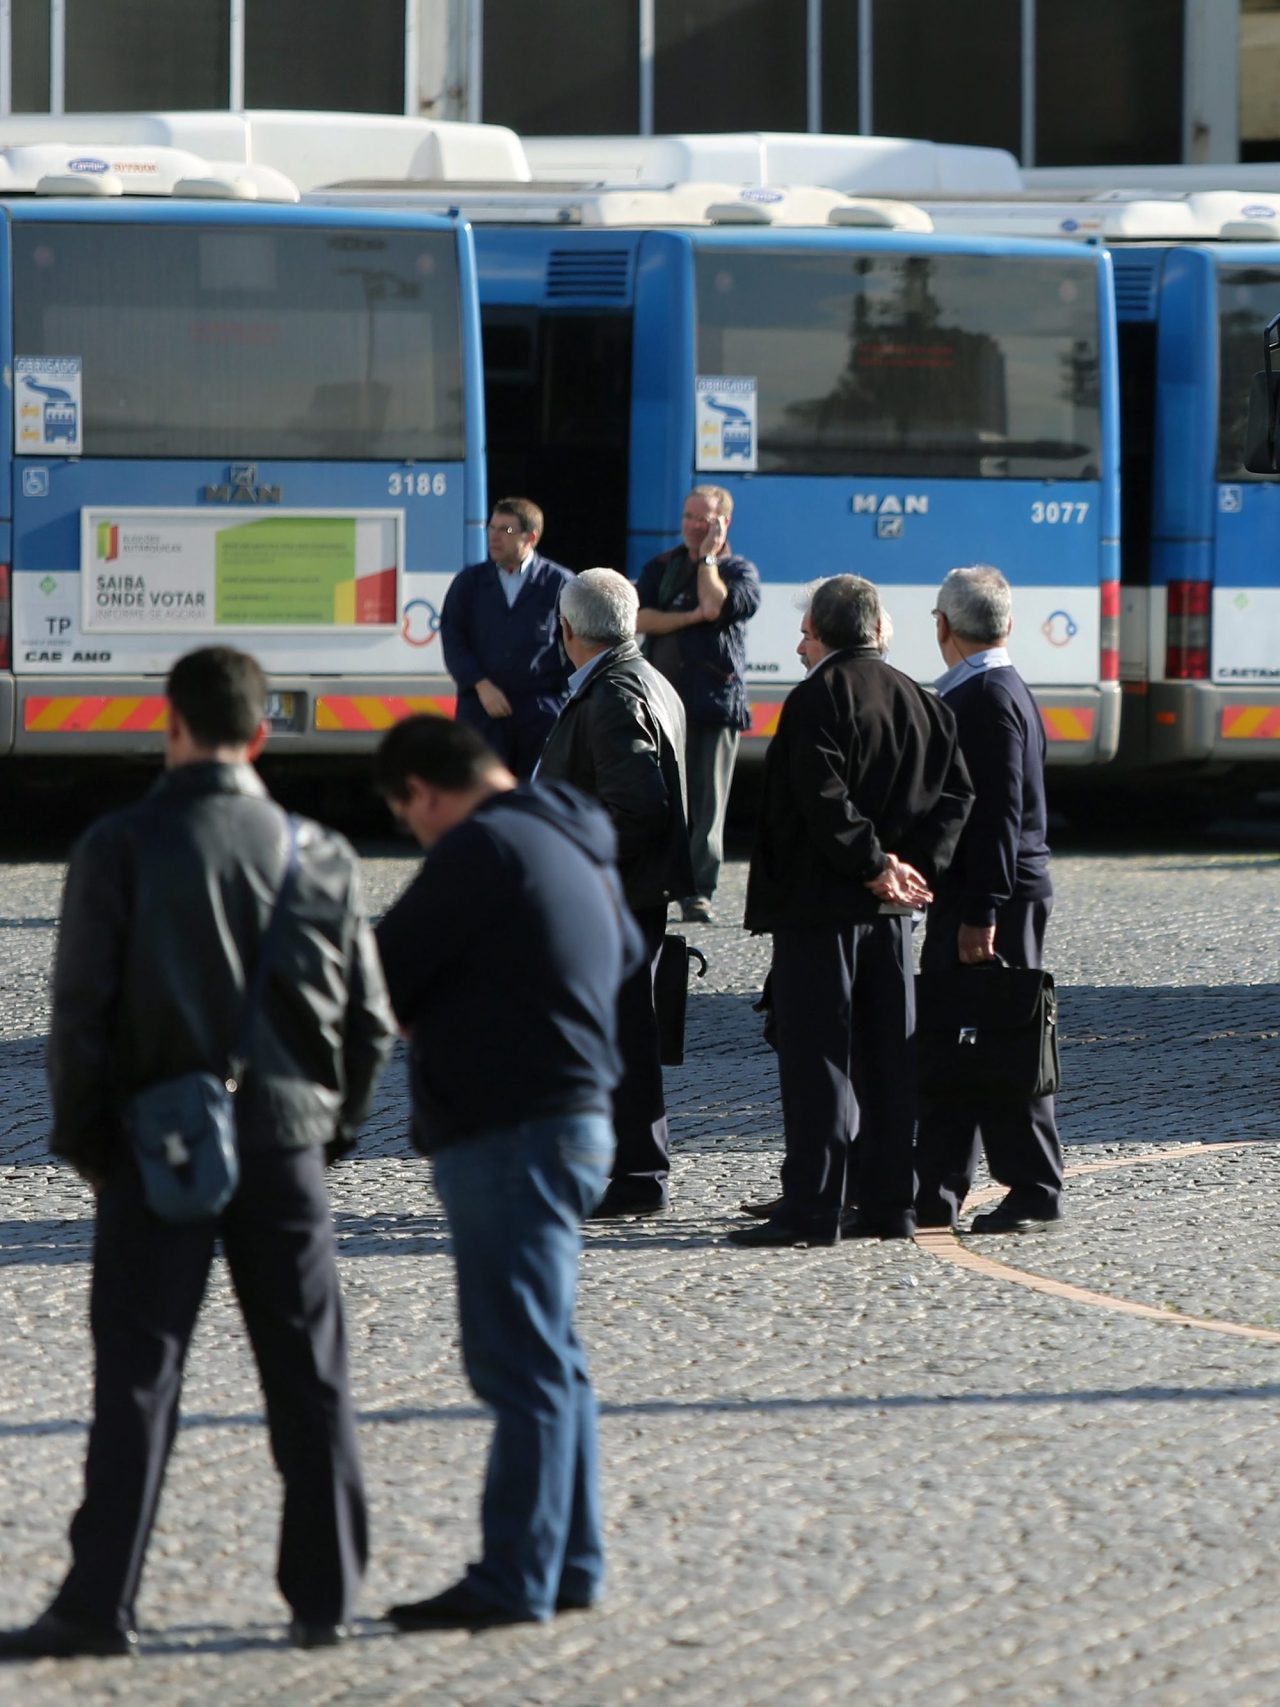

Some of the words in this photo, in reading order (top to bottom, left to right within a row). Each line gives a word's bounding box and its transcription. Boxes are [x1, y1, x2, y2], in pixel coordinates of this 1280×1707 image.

[203, 484, 282, 503] MAN
[388, 472, 447, 497] 3186
[851, 494, 930, 514] MAN
[1031, 501, 1089, 525] 3077
[96, 575, 146, 592] SAIBA
[96, 592, 146, 608] ONDE
[150, 590, 206, 608] VOTAR
[44, 616, 72, 636] TP
